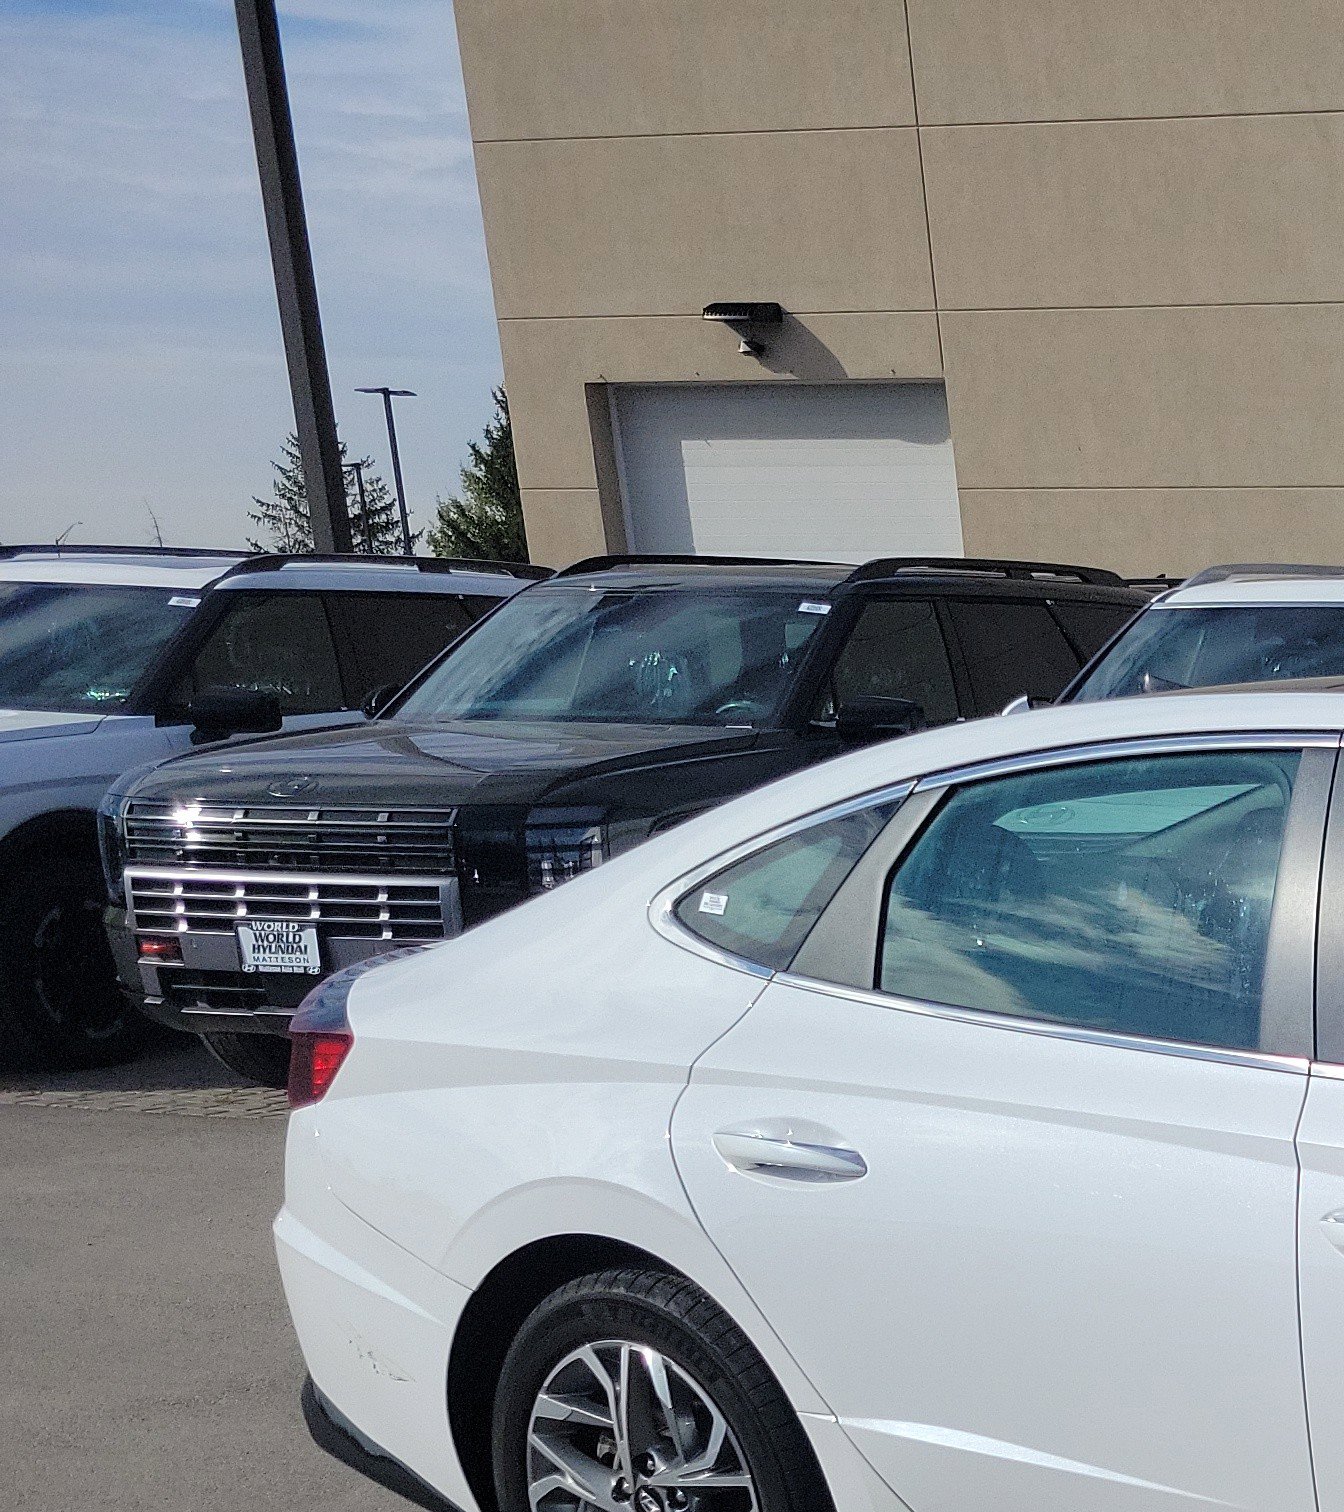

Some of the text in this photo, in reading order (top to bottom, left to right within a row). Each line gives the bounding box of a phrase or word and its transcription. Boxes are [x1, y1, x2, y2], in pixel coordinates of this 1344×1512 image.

[251, 921, 299, 932] WORLD
[253, 932, 302, 943] WORLD
[252, 944, 308, 954] HYUNDAI
[253, 956, 309, 964] MATTESON
